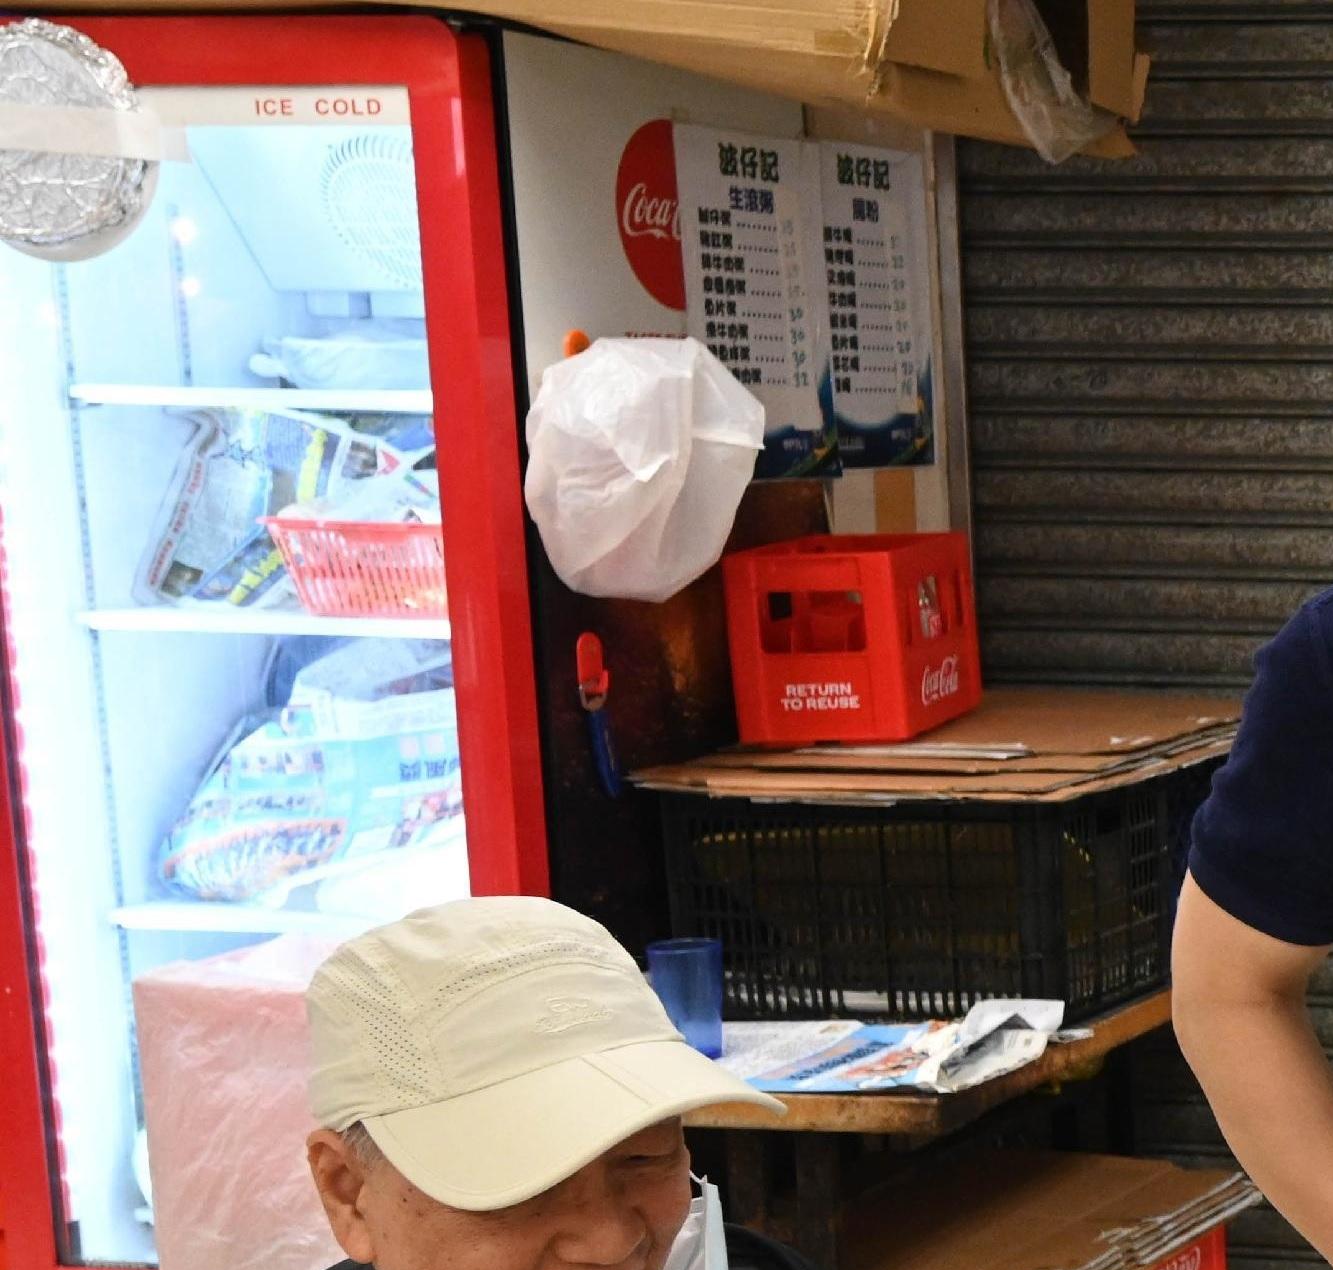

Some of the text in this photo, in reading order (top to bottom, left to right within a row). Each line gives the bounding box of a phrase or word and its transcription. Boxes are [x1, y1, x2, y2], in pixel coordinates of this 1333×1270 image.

[255, 98, 381, 115] ICE COLD
[786, 682, 852, 697] RETURN
[780, 697, 861, 710] TO REUSE
